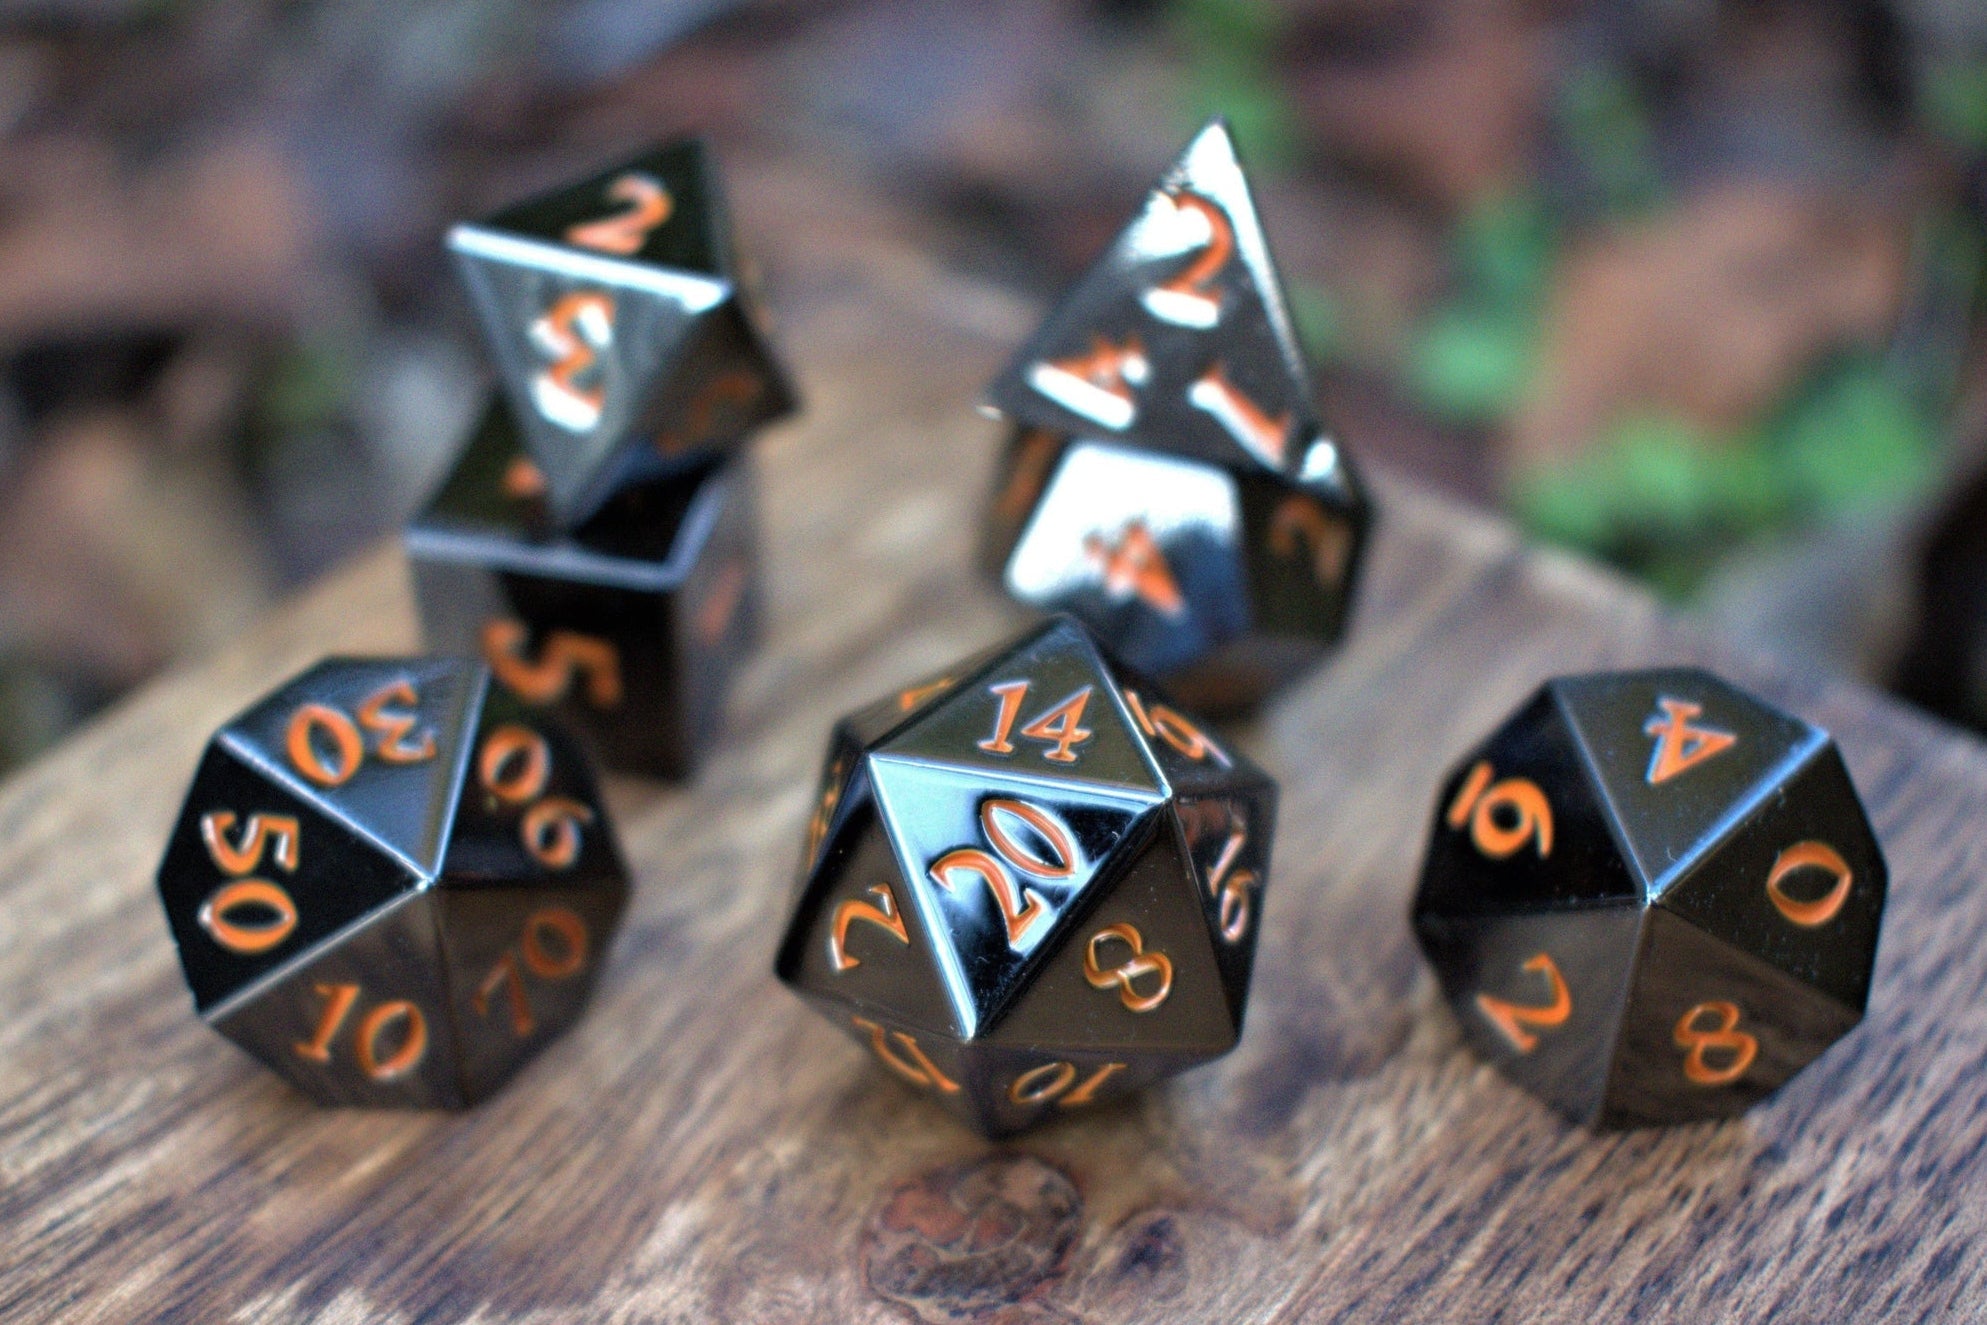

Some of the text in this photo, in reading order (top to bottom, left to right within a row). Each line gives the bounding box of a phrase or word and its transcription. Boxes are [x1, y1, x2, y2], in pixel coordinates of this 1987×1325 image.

[566, 171, 674, 254] 2
[1142, 192, 1234, 329] 2
[530, 293, 615, 433] 3
[1188, 362, 1291, 474] 1
[481, 617, 623, 709] 5
[286, 679, 437, 788] 30
[977, 679, 1094, 764] 14
[1643, 697, 1737, 784] 4
[1447, 760, 1554, 859] 6
[200, 811, 299, 954] 50
[929, 799, 1080, 948] 20
[1767, 841, 1852, 927] 0
[473, 907, 588, 1038] 70
[831, 881, 910, 972] 2
[1083, 922, 1173, 1013] 8
[294, 983, 427, 1080] 10
[1477, 953, 1572, 1055] 2
[1673, 1000, 1758, 1085] 8
[1009, 1061, 1127, 1107] 10
